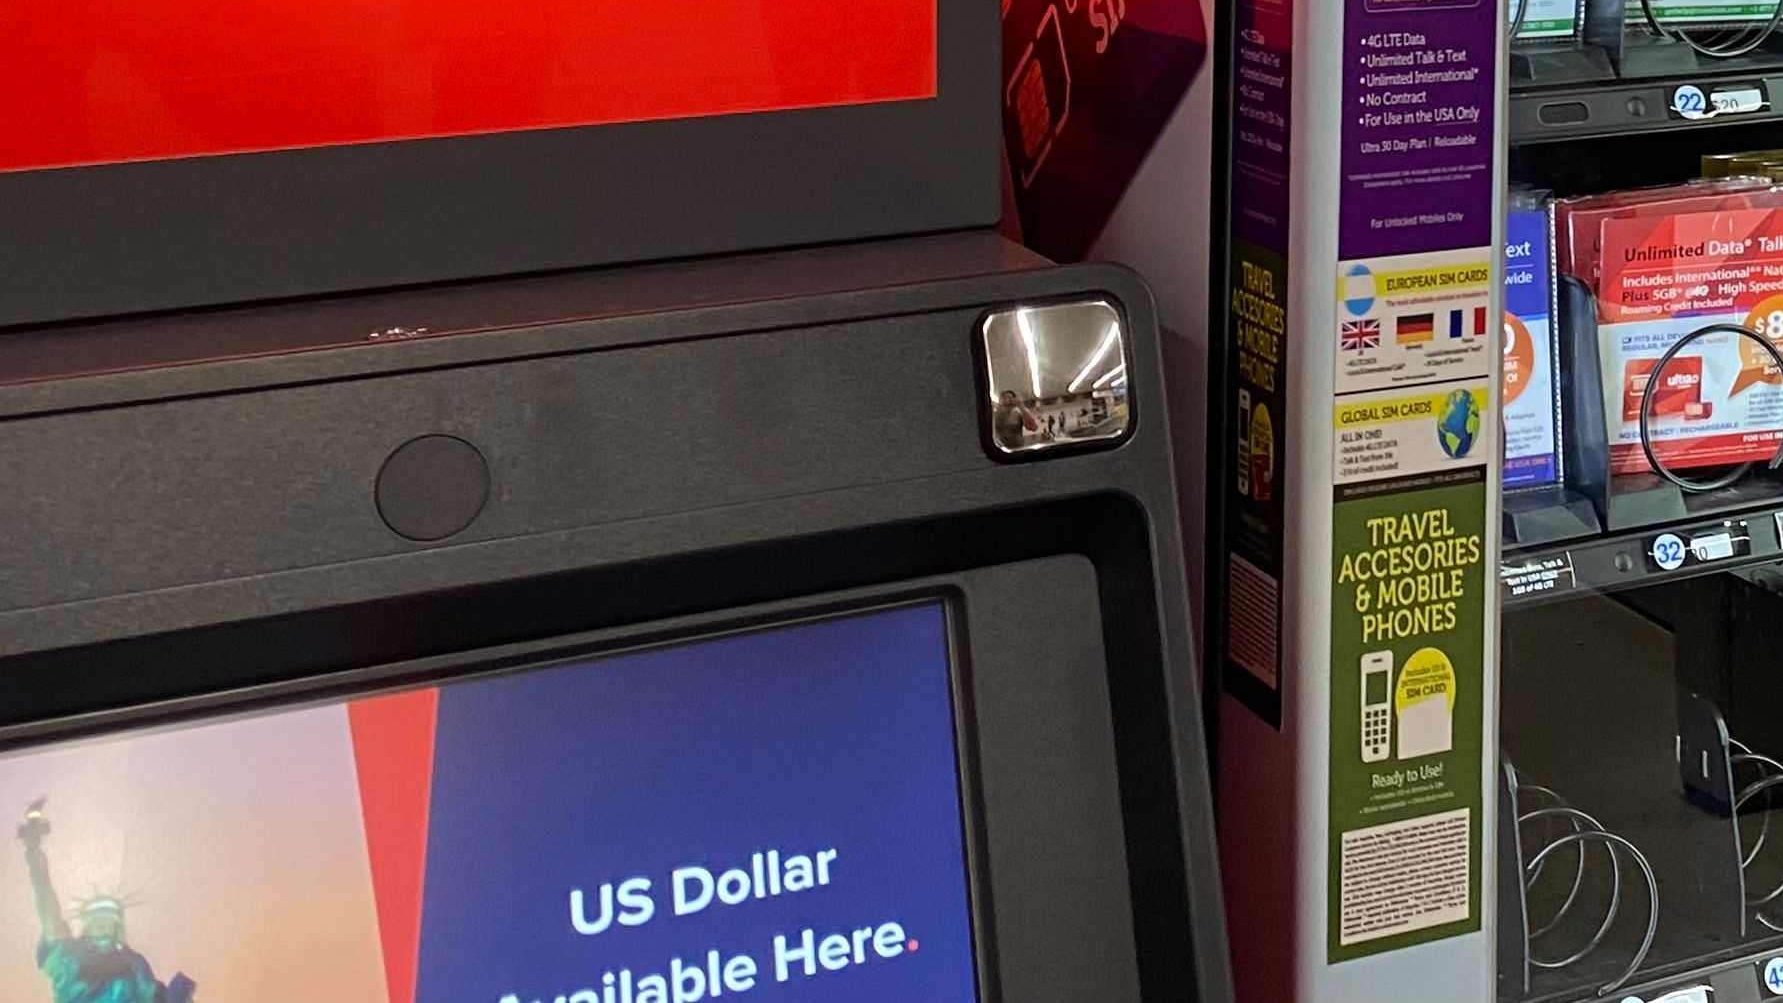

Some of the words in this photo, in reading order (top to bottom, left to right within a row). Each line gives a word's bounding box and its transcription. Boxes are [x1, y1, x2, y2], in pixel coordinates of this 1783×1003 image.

[1367, 34, 1382, 47] 4G
[1384, 33, 1402, 46] LTE
[1404, 33, 1425, 46] Data
[1367, 52, 1414, 67] Unlimited
[1416, 51, 1435, 64] Talk
[1437, 51, 1444, 63] &
[1446, 50, 1466, 62] Text
[1366, 94, 1380, 106] No
[1383, 92, 1426, 105] Contract
[1678, 92, 1703, 112] 22
[1365, 114, 1382, 126] For
[1384, 112, 1402, 124] Use
[1404, 112, 1414, 123] in
[1416, 110, 1432, 122] the
[1435, 109, 1454, 121] USA
[1457, 106, 1480, 122] Only
[1625, 242, 1704, 262] Unlimited
[1387, 275, 1437, 290] EUROPEAN
[1439, 272, 1456, 285] SIM
[1457, 269, 1487, 283] CARDS
[1341, 410, 1379, 424] GLOBAL
[1382, 406, 1398, 419] SIM
[1401, 401, 1432, 415] CARDS
[1367, 508, 1455, 546] TRAVEL
[1338, 535, 1480, 584] ACCESORIES
[1656, 542, 1683, 563] 32
[1355, 583, 1371, 613] &
[1377, 569, 1464, 610] MOBILE
[1363, 602, 1456, 643] PHONES
[1372, 771, 1405, 790] Ready
[1407, 770, 1418, 782] to
[1420, 762, 1443, 781] Use!
[569, 876, 656, 937] US
[671, 846, 838, 916] Dollar
[773, 919, 919, 983] Here.
